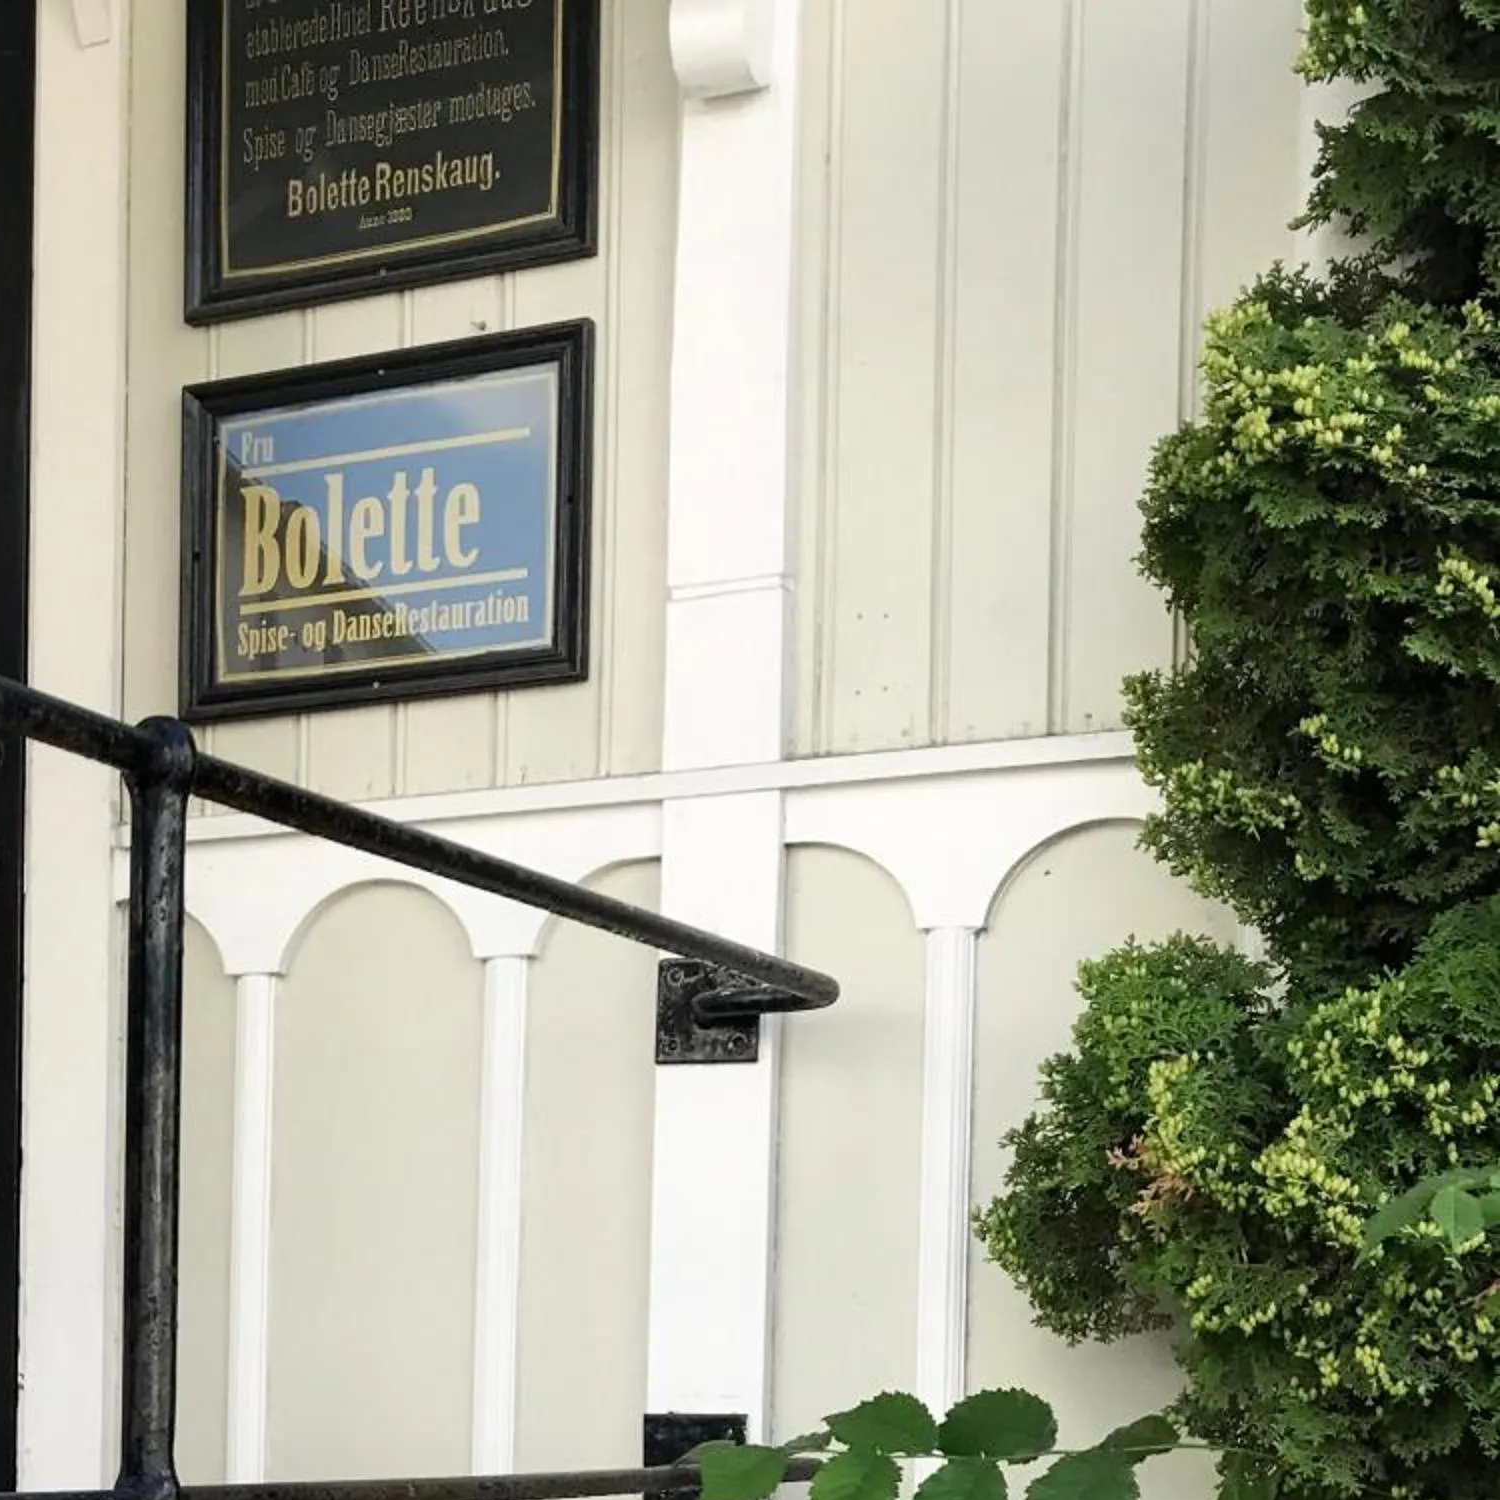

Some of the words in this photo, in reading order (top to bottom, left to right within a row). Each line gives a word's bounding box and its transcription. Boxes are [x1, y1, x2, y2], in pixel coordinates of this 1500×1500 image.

[319, 65, 341, 101] og
[244, 125, 285, 172] Spise
[295, 125, 317, 162] og
[288, 169, 370, 217] Bolette
[375, 151, 500, 200] Renskaug.
[241, 431, 274, 465] Fru
[238, 466, 481, 597] Bolette
[238, 620, 296, 660] Spise-
[302, 619, 326, 652] og
